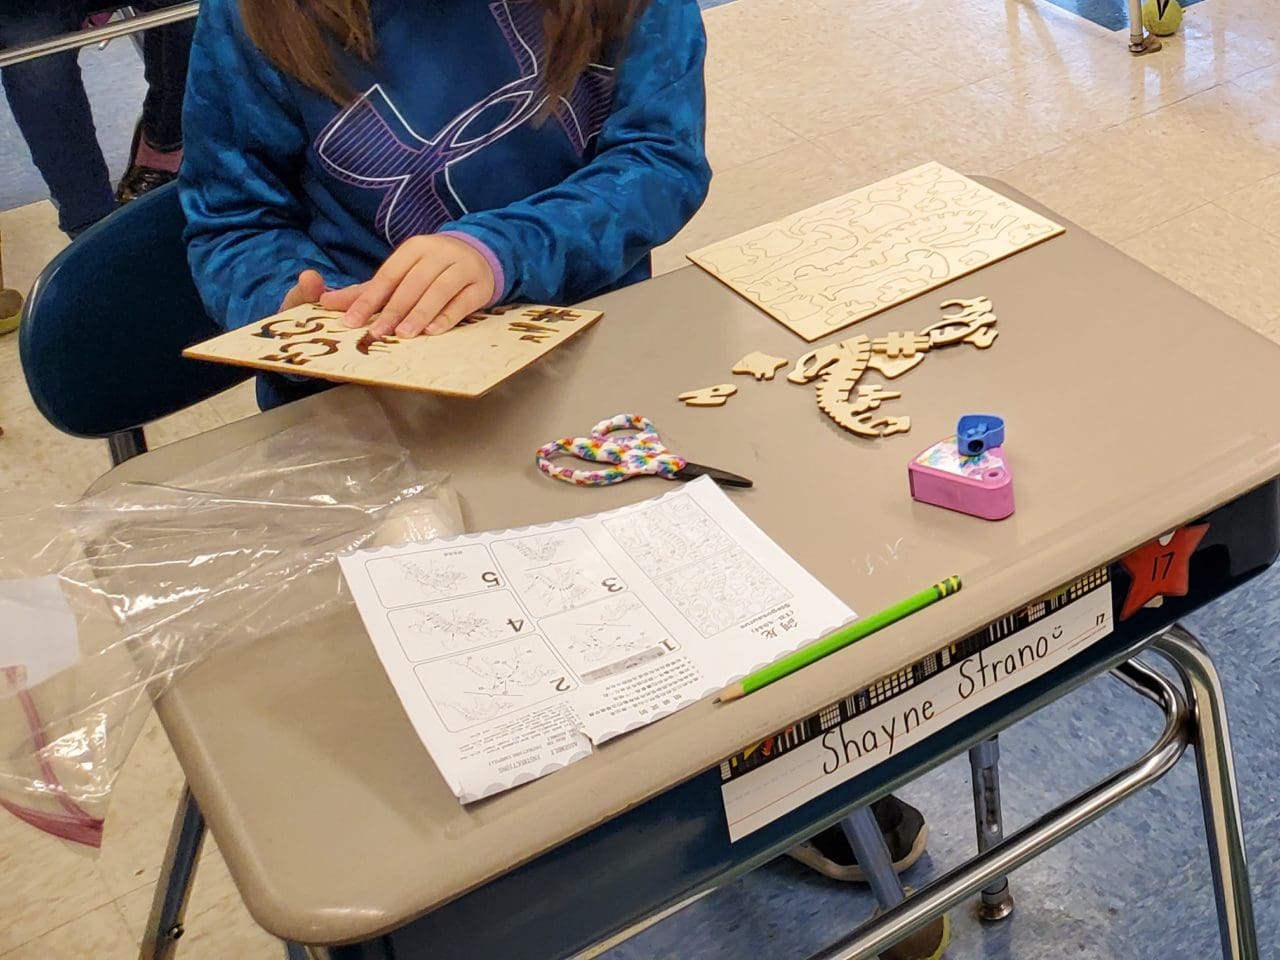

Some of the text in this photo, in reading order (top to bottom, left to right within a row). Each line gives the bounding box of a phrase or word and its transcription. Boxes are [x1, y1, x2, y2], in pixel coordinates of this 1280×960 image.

[1152, 551, 1175, 582] 17
[481, 571, 502, 589] 5
[601, 576, 624, 593] 3
[506, 617, 525, 633] 4
[1096, 612, 1106, 626] 17
[549, 676, 571, 692] 2
[821, 632, 1049, 775] Shayne Strano
